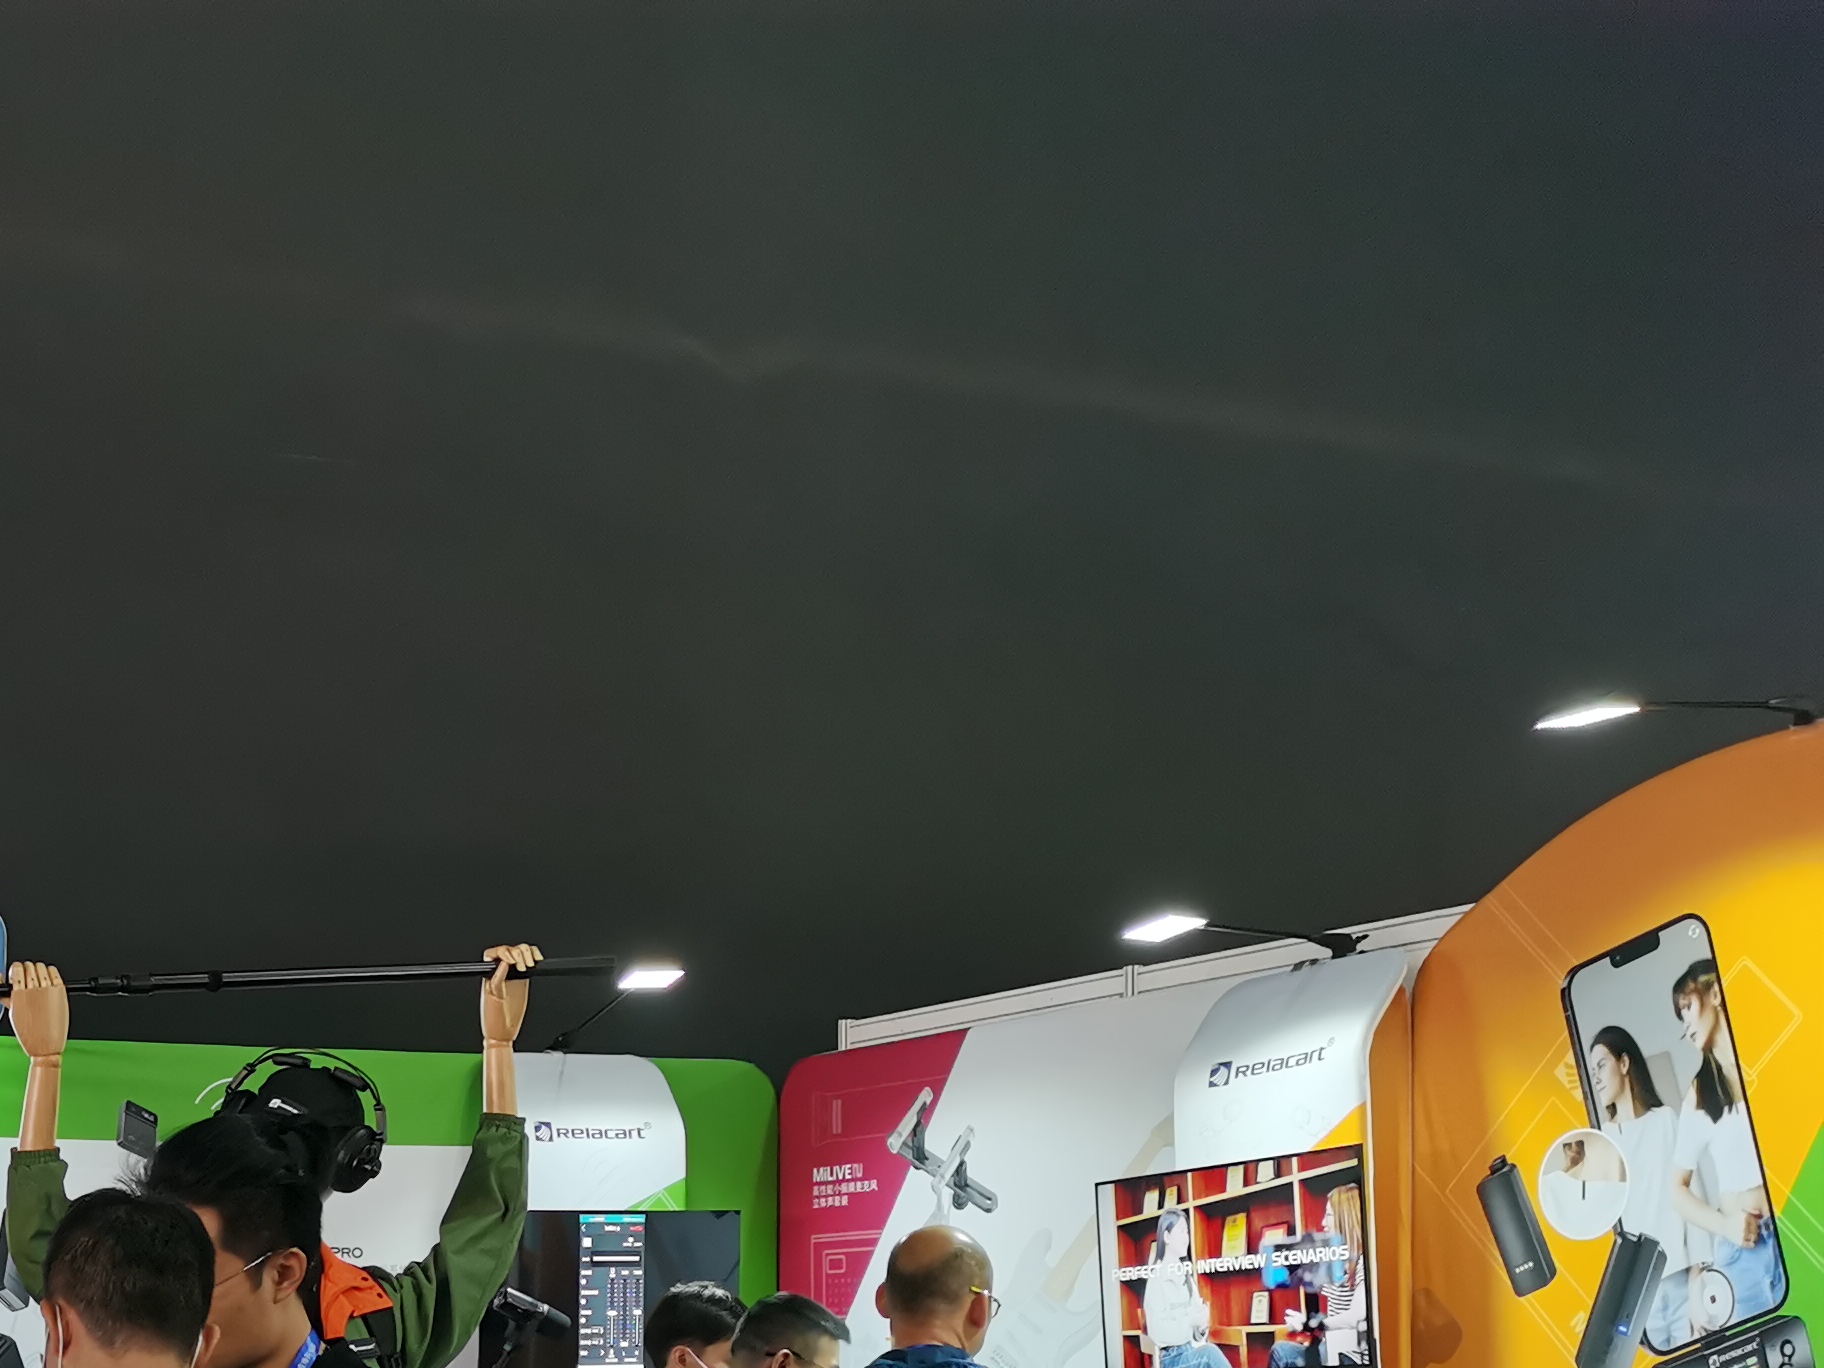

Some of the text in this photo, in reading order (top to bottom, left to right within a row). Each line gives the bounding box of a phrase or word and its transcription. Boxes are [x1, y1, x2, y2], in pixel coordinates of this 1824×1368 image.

[1112, 1244, 1350, 1282] PERFECT FOR INTERVIEW SCENARIOS
